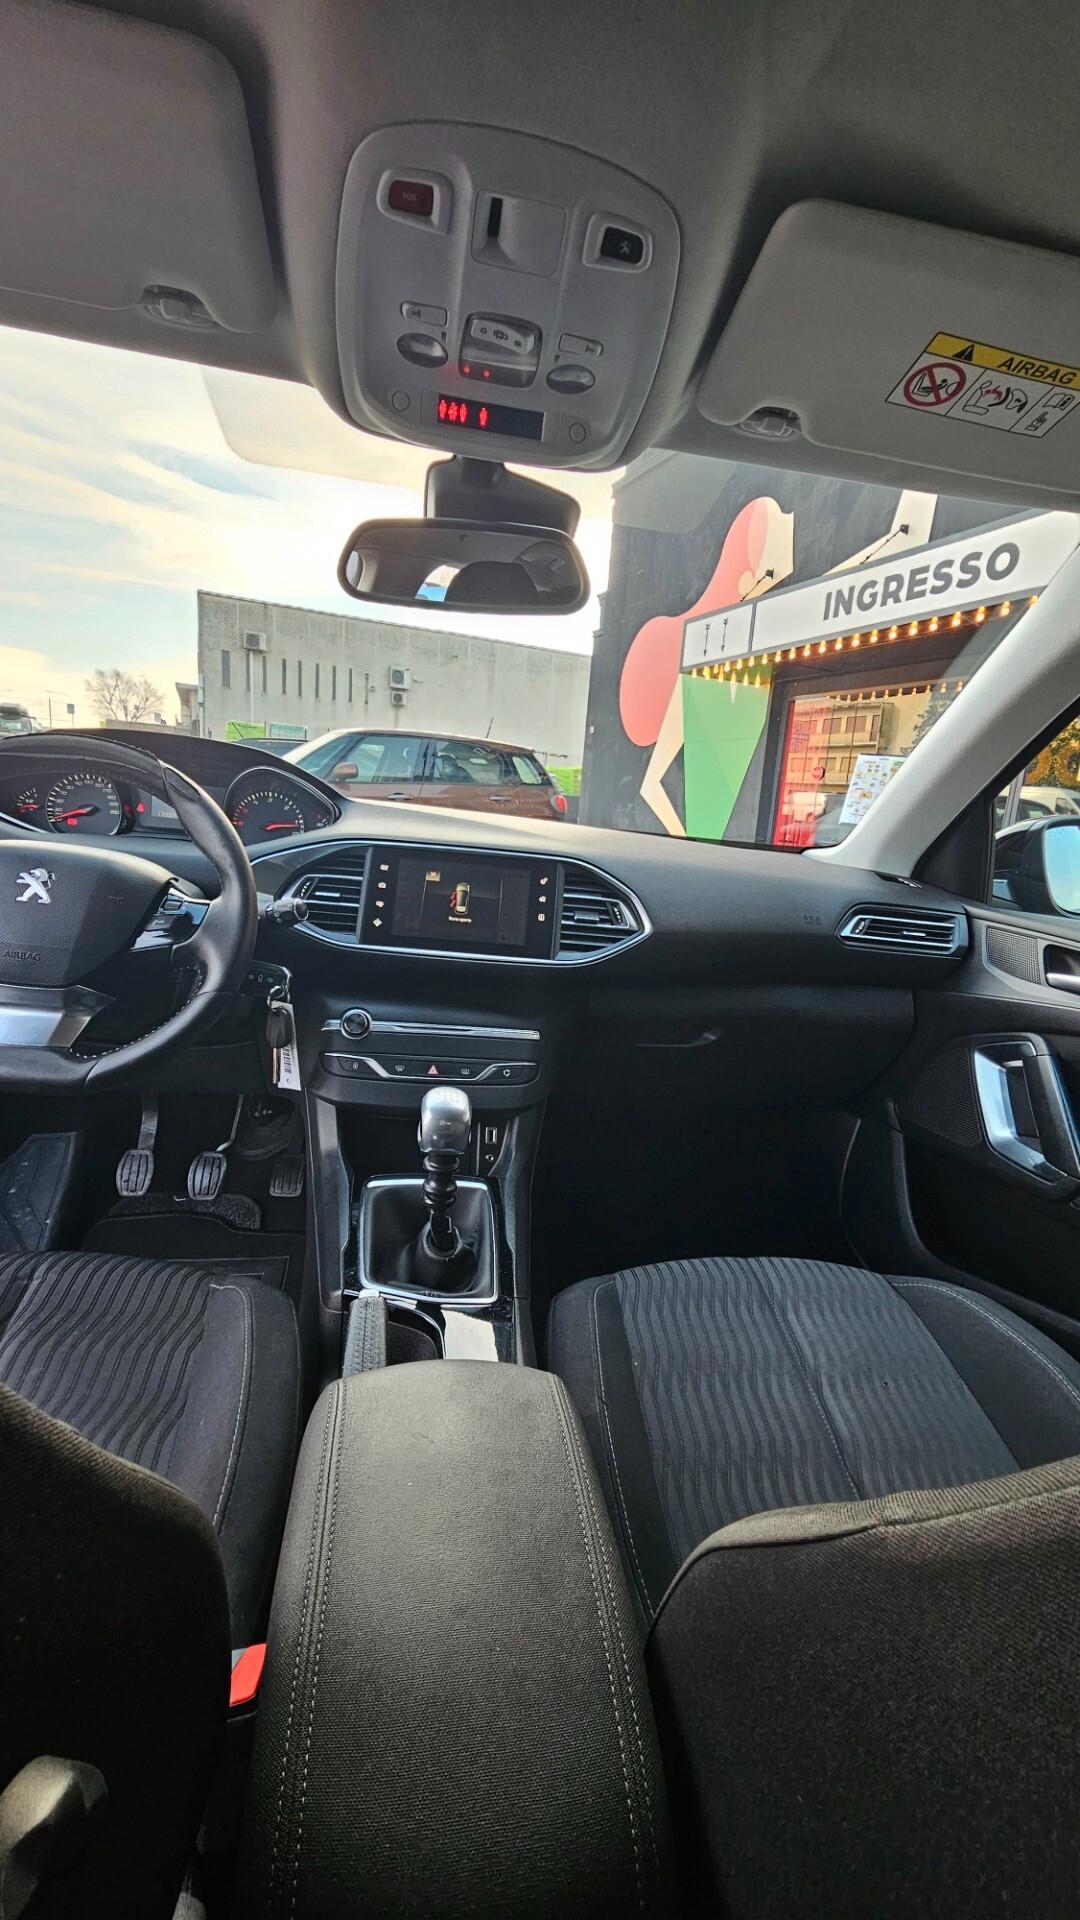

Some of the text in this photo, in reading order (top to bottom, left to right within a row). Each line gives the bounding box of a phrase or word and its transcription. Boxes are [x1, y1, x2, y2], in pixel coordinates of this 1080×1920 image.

[997, 357, 1077, 384] AIRBAG
[823, 542, 1020, 621] INGRESSO
[3, 950, 41, 961] AIRBAG
